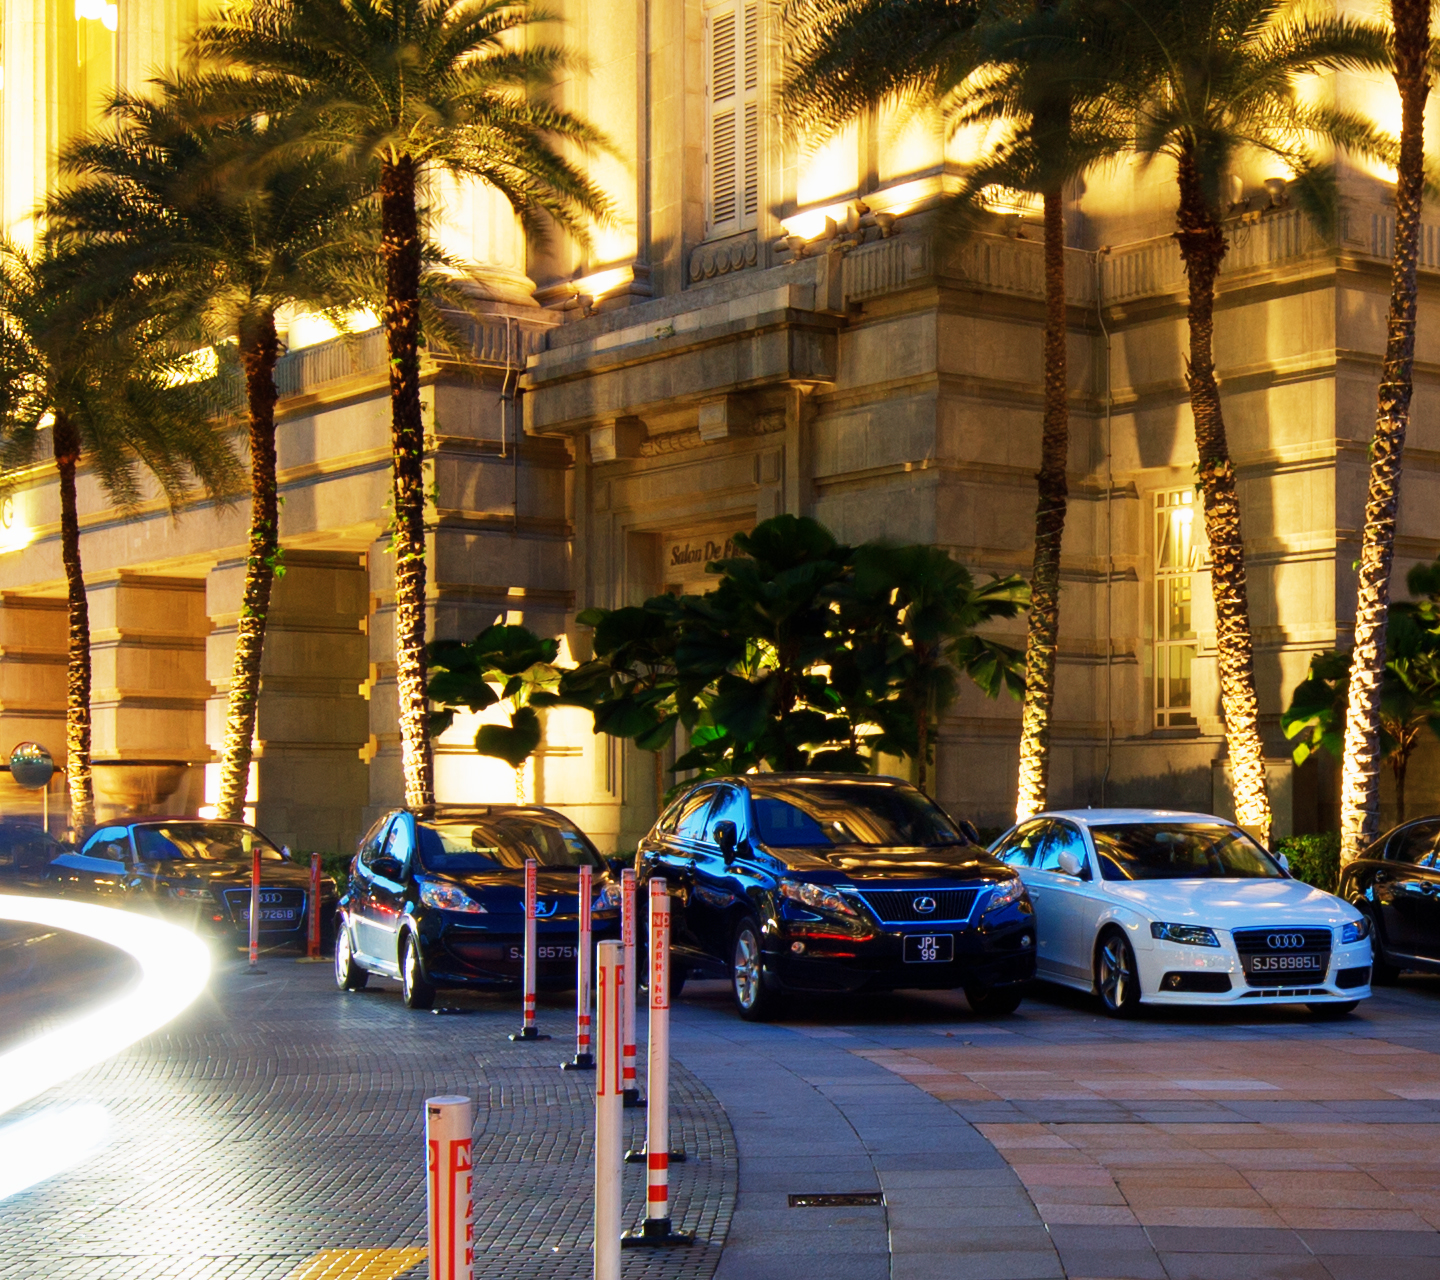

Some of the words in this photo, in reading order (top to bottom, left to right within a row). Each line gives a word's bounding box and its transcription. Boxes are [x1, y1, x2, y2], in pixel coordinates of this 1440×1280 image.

[917, 936, 940, 949] JPL
[921, 948, 936, 960] 99
[655, 929, 664, 1005] PARKING
[1253, 956, 1320, 970] SJS8985L
